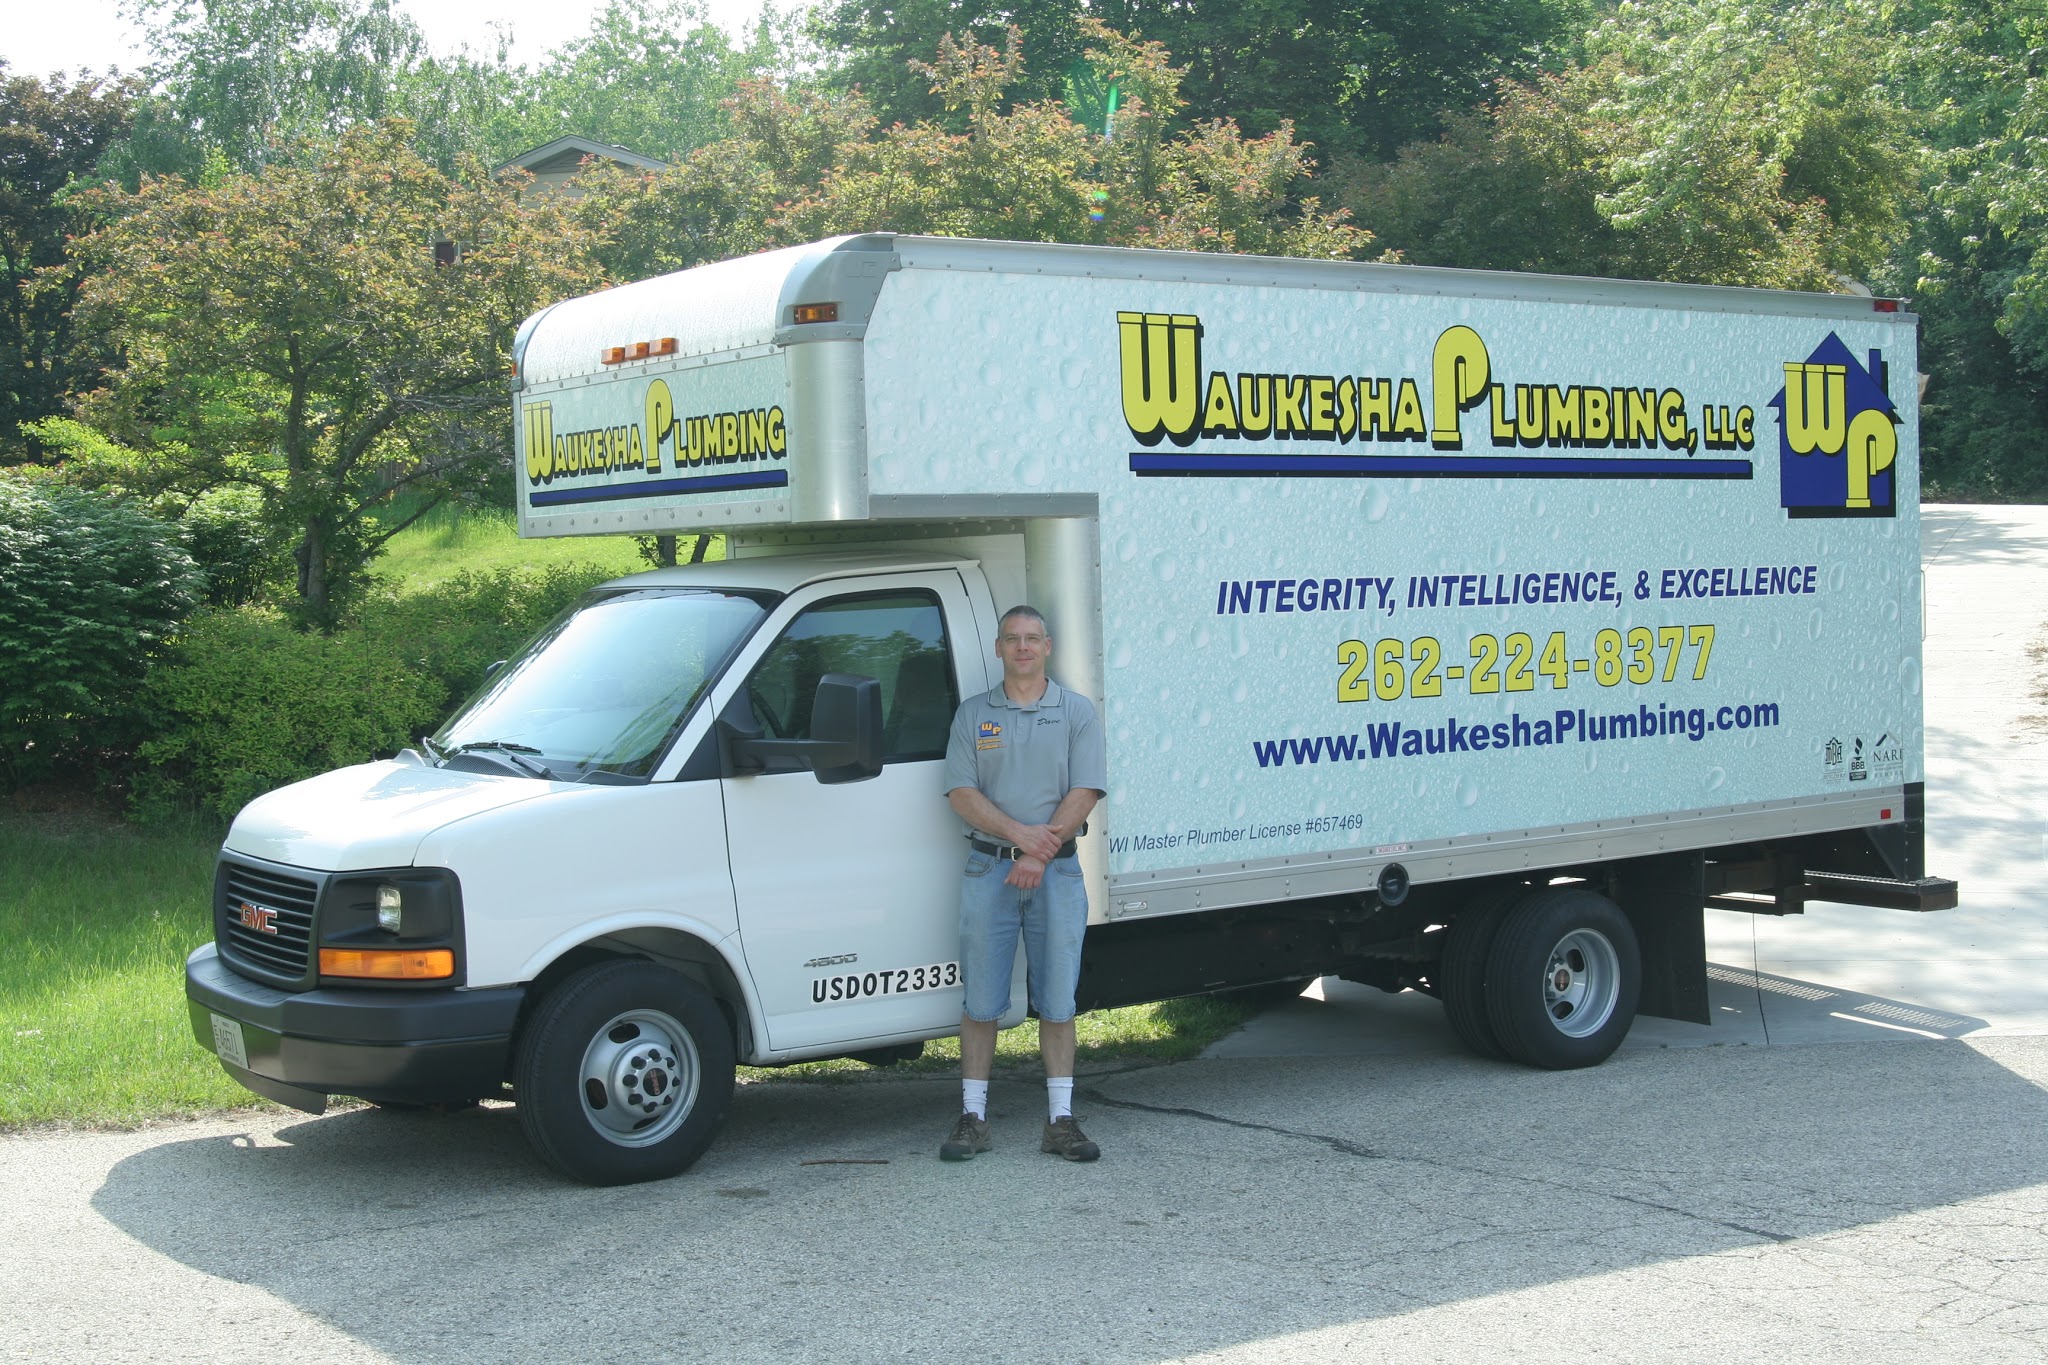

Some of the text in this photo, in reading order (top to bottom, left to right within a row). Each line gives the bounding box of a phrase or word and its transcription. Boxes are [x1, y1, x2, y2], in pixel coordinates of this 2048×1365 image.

[1116, 311, 1427, 448] WAUKESHA
[1703, 404, 1755, 451] LLC
[523, 378, 787, 486] WAUKESHA PLUMBING
[1216, 565, 1818, 617] INTEGRITY, INTELLIGENCE, & EXCELLENCE
[1337, 624, 1716, 703] 262-224-8377
[1252, 702, 1780, 768] www.WaukeshaPlumbing.com
[1851, 761, 1865, 770] BBB
[1109, 814, 1363, 854] WI Master Plumber License #657469
[240, 902, 278, 935] GMC
[812, 963, 964, 1003] USDOT2333
